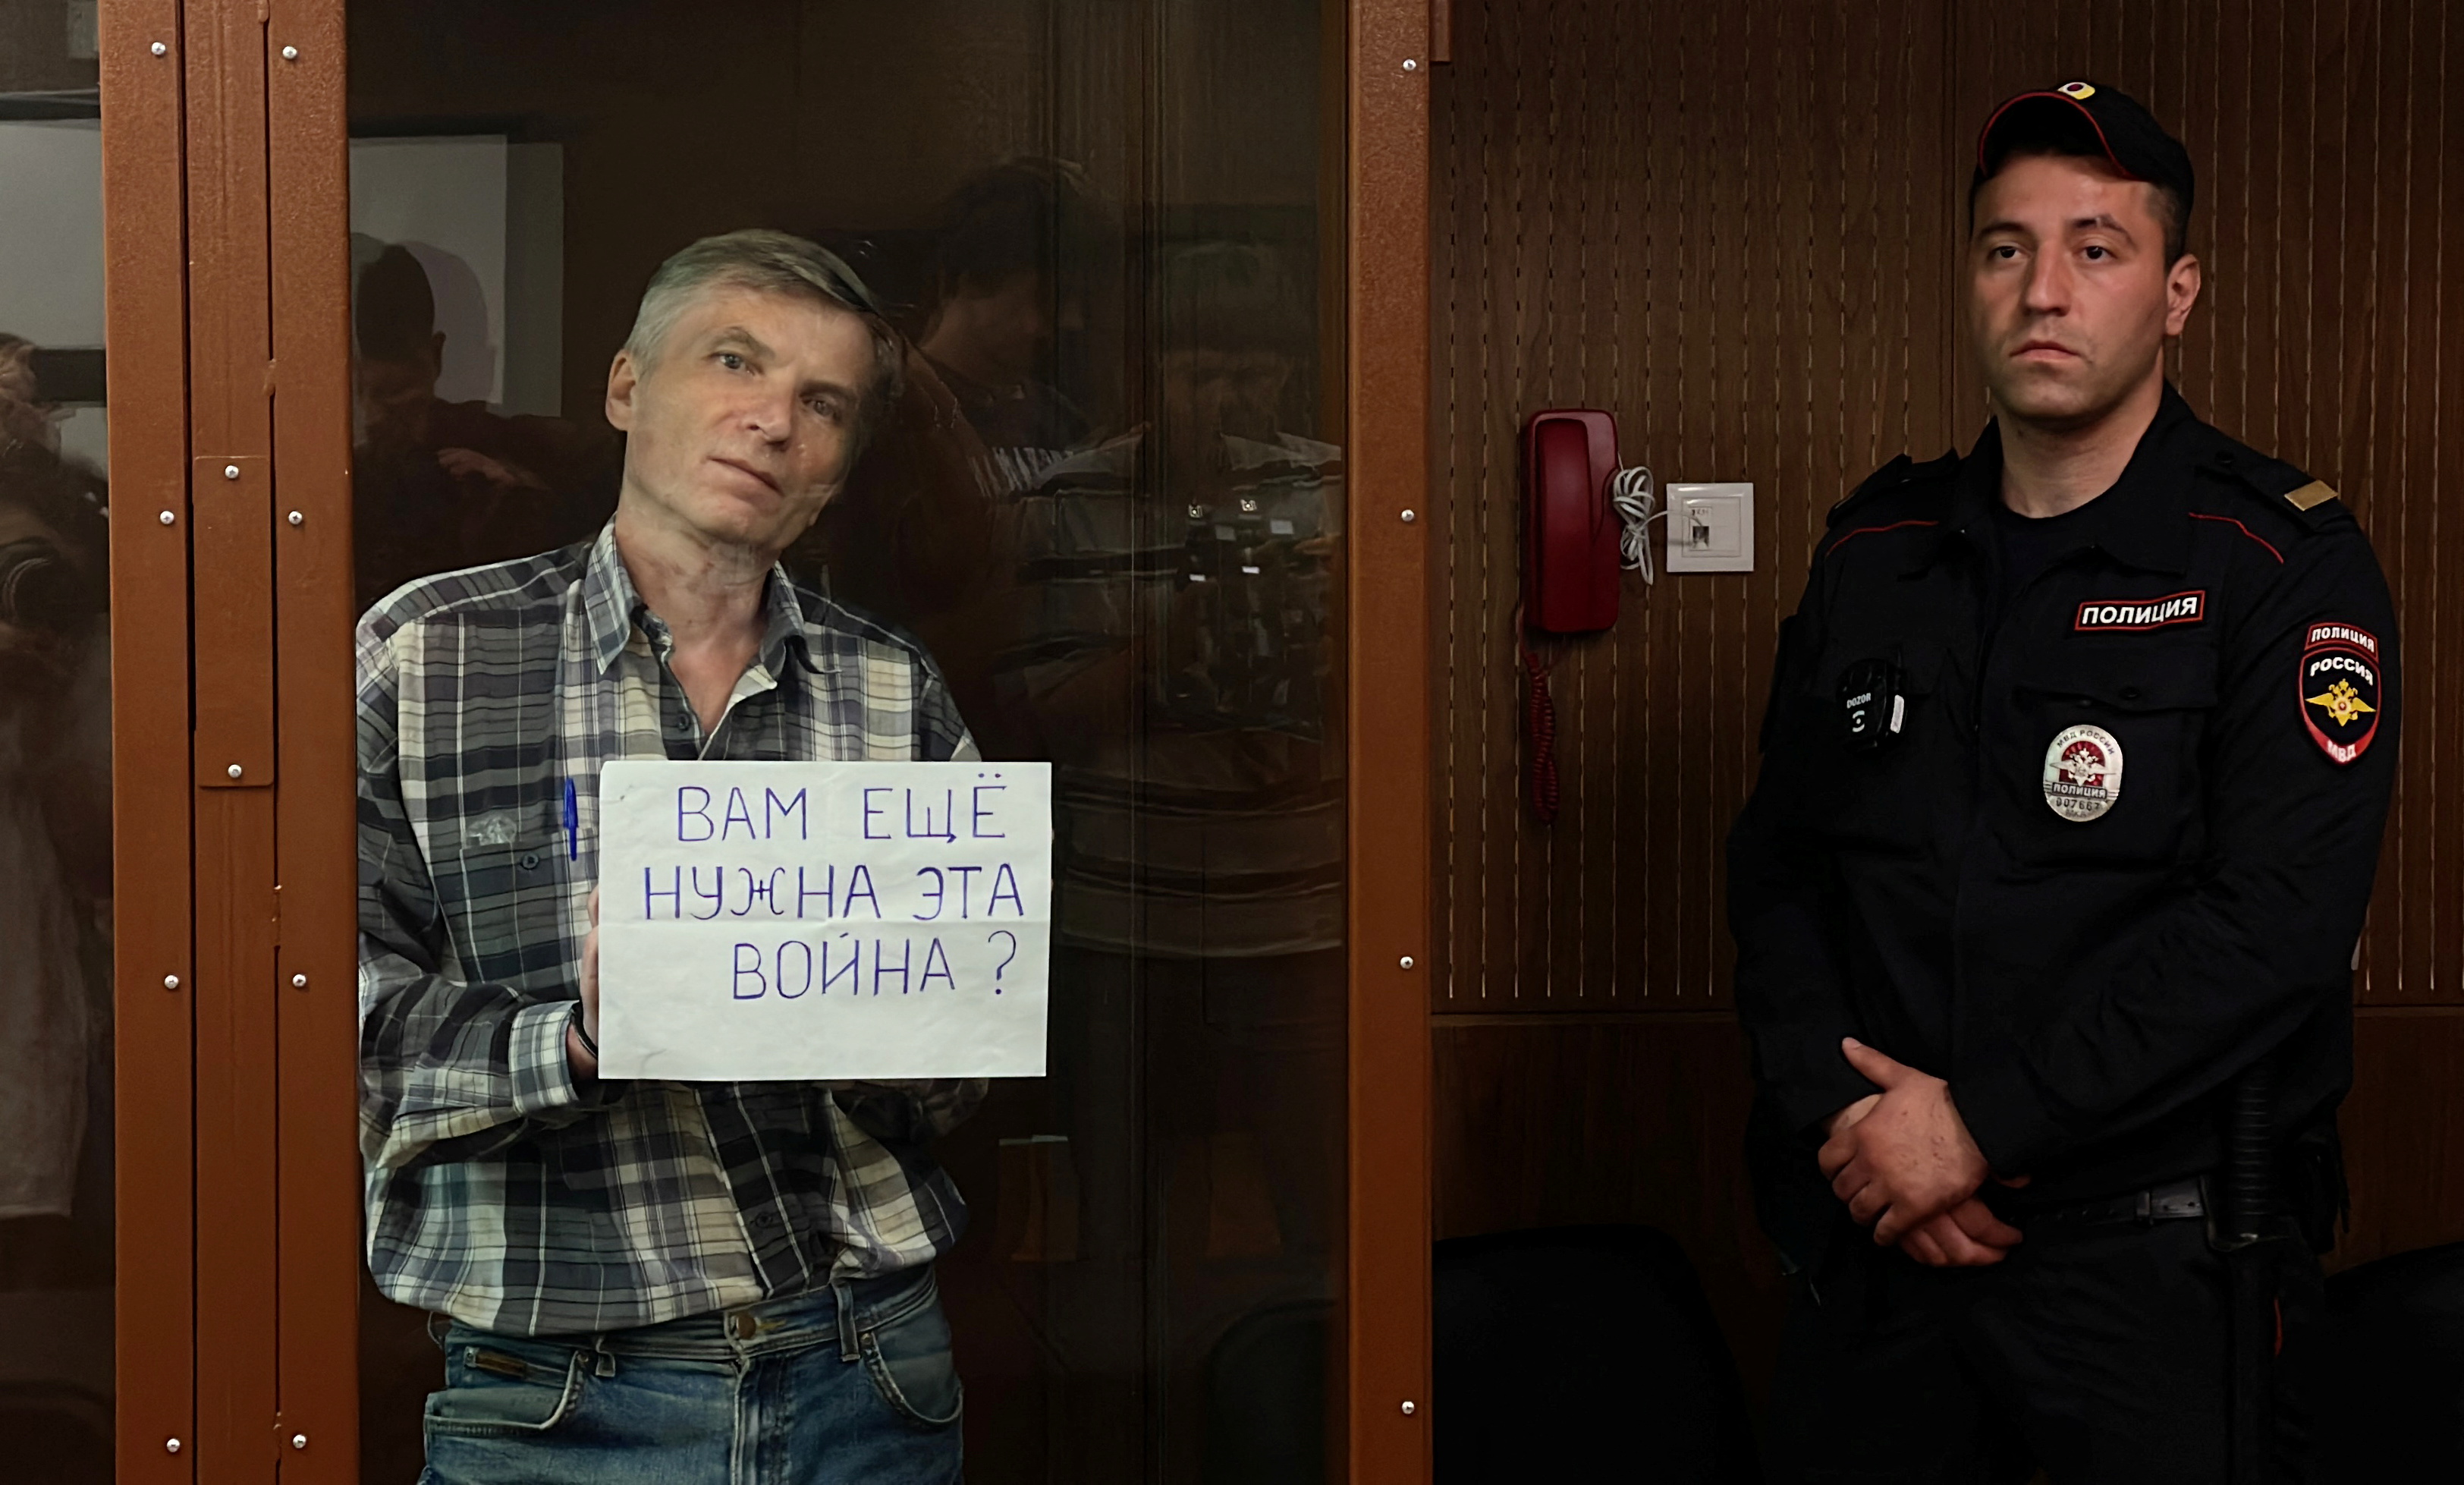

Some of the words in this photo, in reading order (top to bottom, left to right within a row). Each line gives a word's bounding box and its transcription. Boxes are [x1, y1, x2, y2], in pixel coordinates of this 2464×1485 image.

[2082, 597, 2198, 625] ПОЛИЦИЯ
[2311, 627, 2375, 653] ПОЛИЦИЯ
[2310, 656, 2374, 686] РОССИЯ
[1846, 692, 1872, 709] DOZOR
[2057, 733, 2077, 748] МВД
[2079, 730, 2115, 755] РОССИИ
[2327, 740, 2356, 763] МВД
[2053, 783, 2106, 799] ПОЛИЦИЯ
[677, 786, 807, 842] ВАМ
[863, 772, 1007, 843] ЕЩЁ
[644, 864, 882, 920] НУЖНА
[912, 863, 1025, 920] ЭТА
[733, 933, 956, 1000] ВОЙНА
